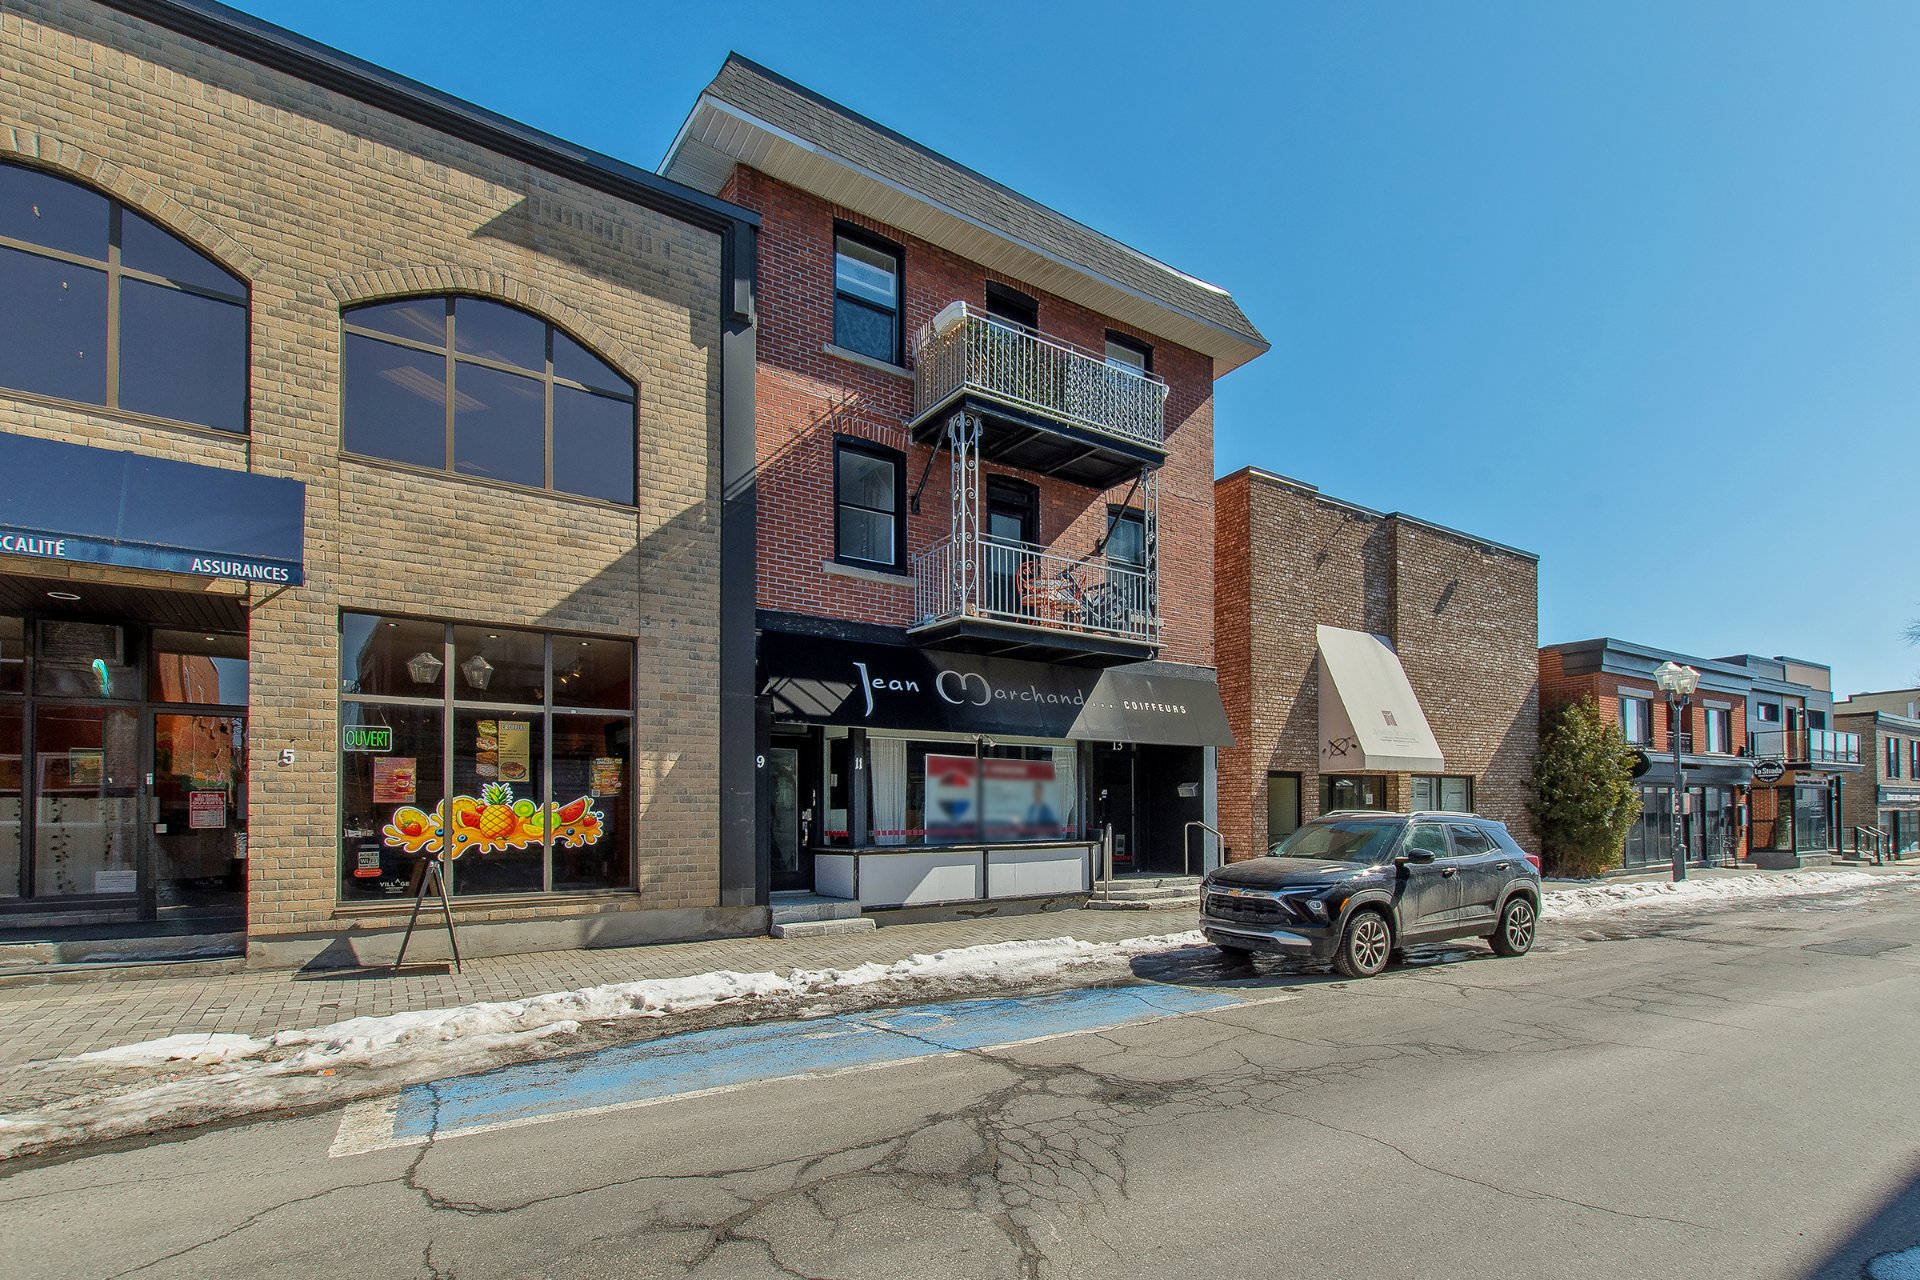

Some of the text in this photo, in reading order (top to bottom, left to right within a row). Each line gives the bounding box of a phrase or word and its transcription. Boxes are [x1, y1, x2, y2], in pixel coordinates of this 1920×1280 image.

[0, 534, 66, 556] CALITÉ
[191, 558, 290, 581] ASSURANCES
[852, 662, 920, 717] Jean
[935, 670, 1086, 706] Marchand
[1123, 700, 1187, 714] COIFFEURS
[346, 730, 390, 747] OUVERT
[1112, 741, 1123, 751] 13
[283, 749, 295, 764] 5
[756, 755, 766, 768] 9
[854, 757, 863, 770] 11
[1754, 766, 1783, 775] La Strada
[379, 878, 410, 887] VILLAGE
